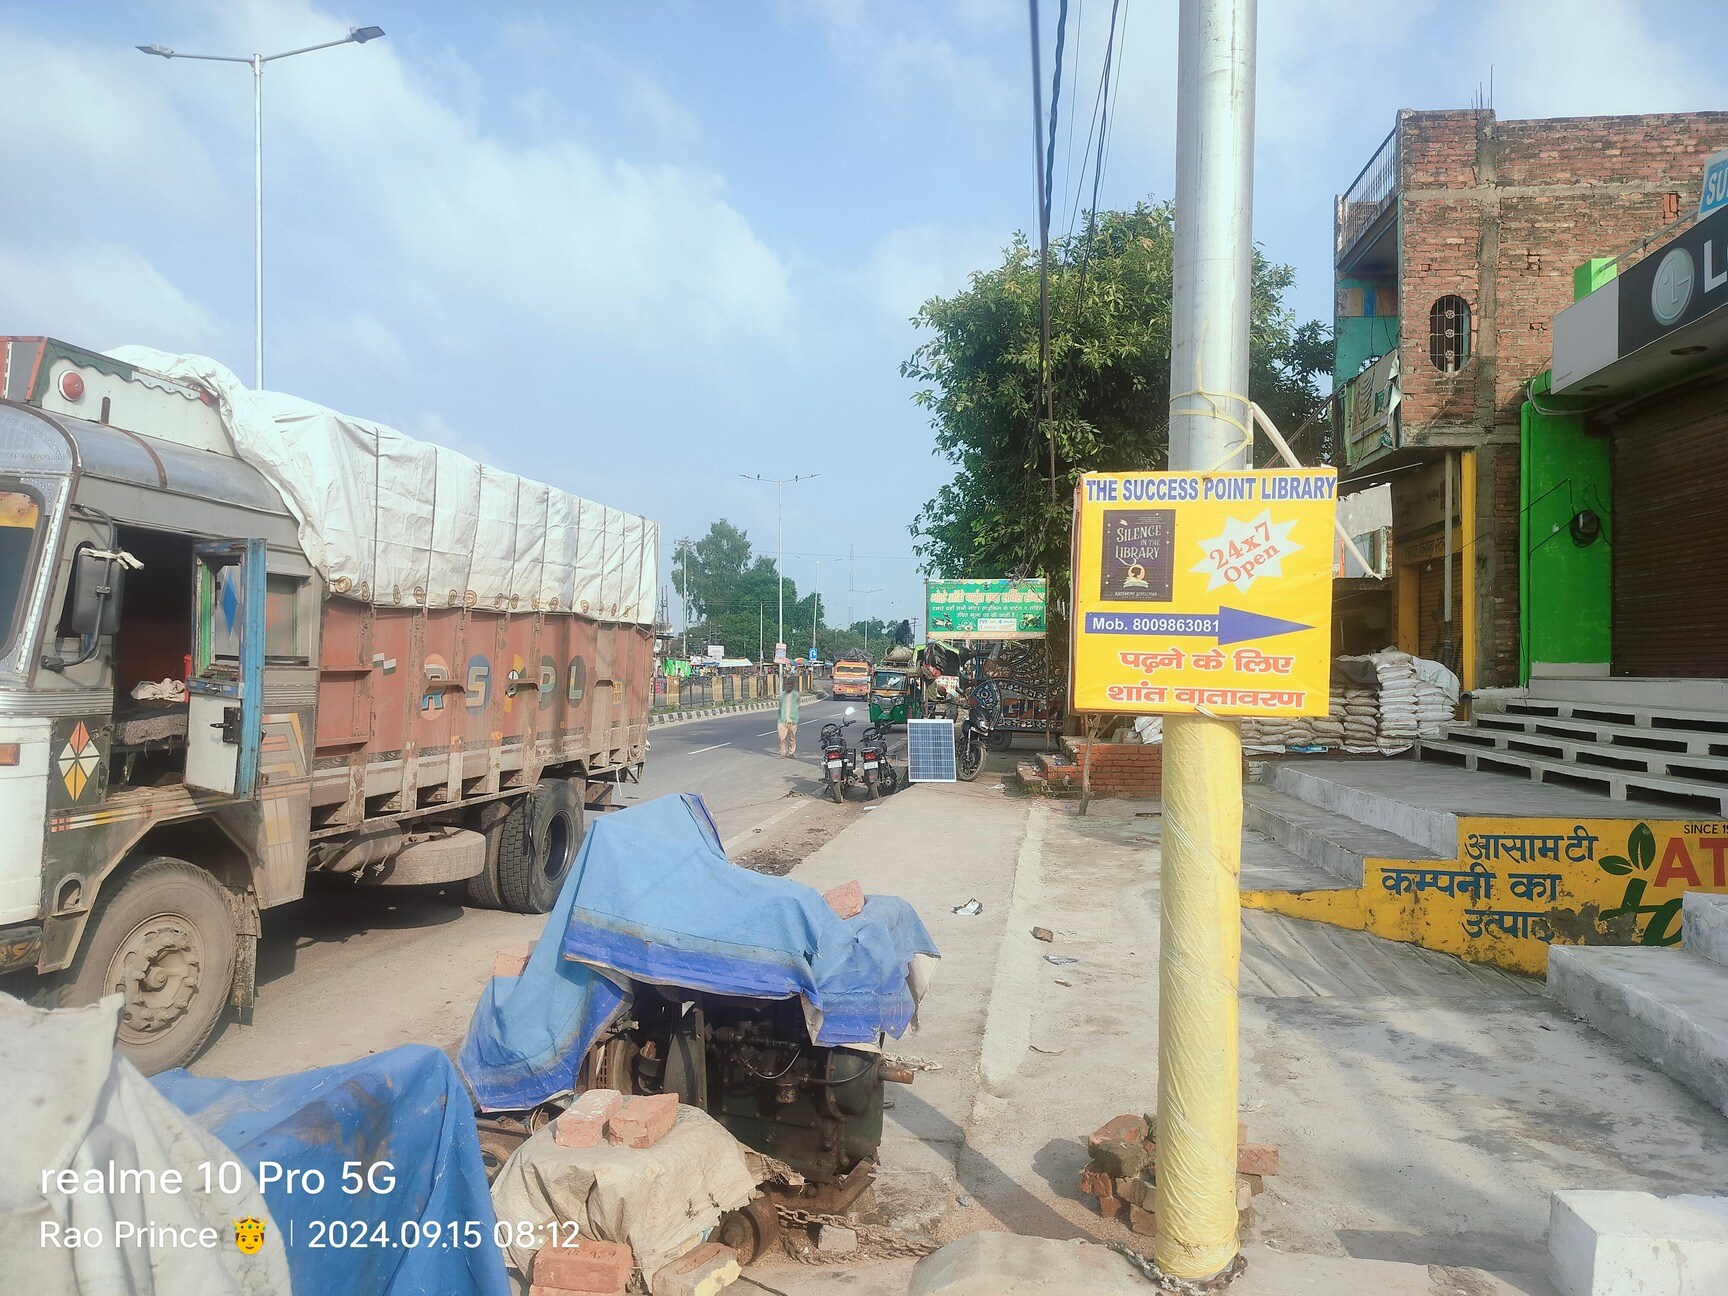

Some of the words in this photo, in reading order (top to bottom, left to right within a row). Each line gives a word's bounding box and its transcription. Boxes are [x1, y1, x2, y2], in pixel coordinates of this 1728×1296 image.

[1086, 479, 1118, 501] THE
[1122, 478, 1199, 501] SUCCESS
[1203, 477, 1257, 500] POINT
[1261, 476, 1337, 500] LIBRARY
[1116, 525, 1162, 542] SILENCE
[1209, 521, 1272, 570] 24x7
[1115, 545, 1160, 562] LIBRARY
[1223, 544, 1280, 583] Open
[1092, 618, 1128, 631] Mob.
[1133, 618, 1220, 633] 8009863081
[1119, 648, 1185, 673] पढ़ने
[1192, 649, 1226, 672] के
[1234, 649, 1295, 674] लिए
[1108, 681, 1168, 703] शांत
[1175, 687, 1305, 708] वातावरण
[1684, 824, 1719, 834] SINCE
[1381, 861, 1497, 900] कम्पनी
[1508, 873, 1563, 902] का
